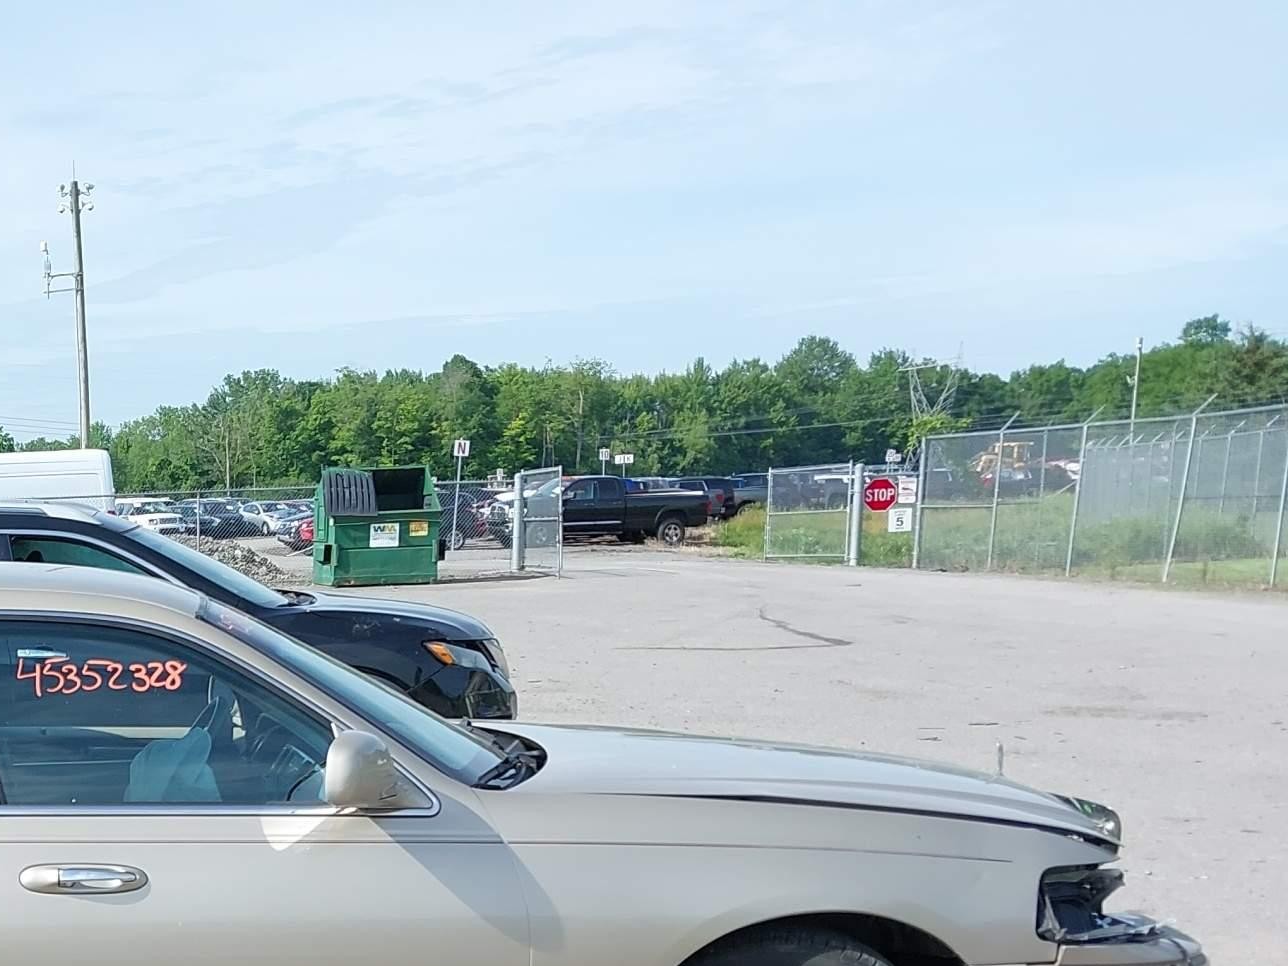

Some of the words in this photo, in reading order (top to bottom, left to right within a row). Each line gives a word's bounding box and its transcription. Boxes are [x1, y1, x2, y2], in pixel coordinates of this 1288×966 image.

[457, 442, 467, 454] N
[865, 488, 895, 502] STOP
[895, 516, 904, 527] 5
[16, 656, 188, 697] 45352328
